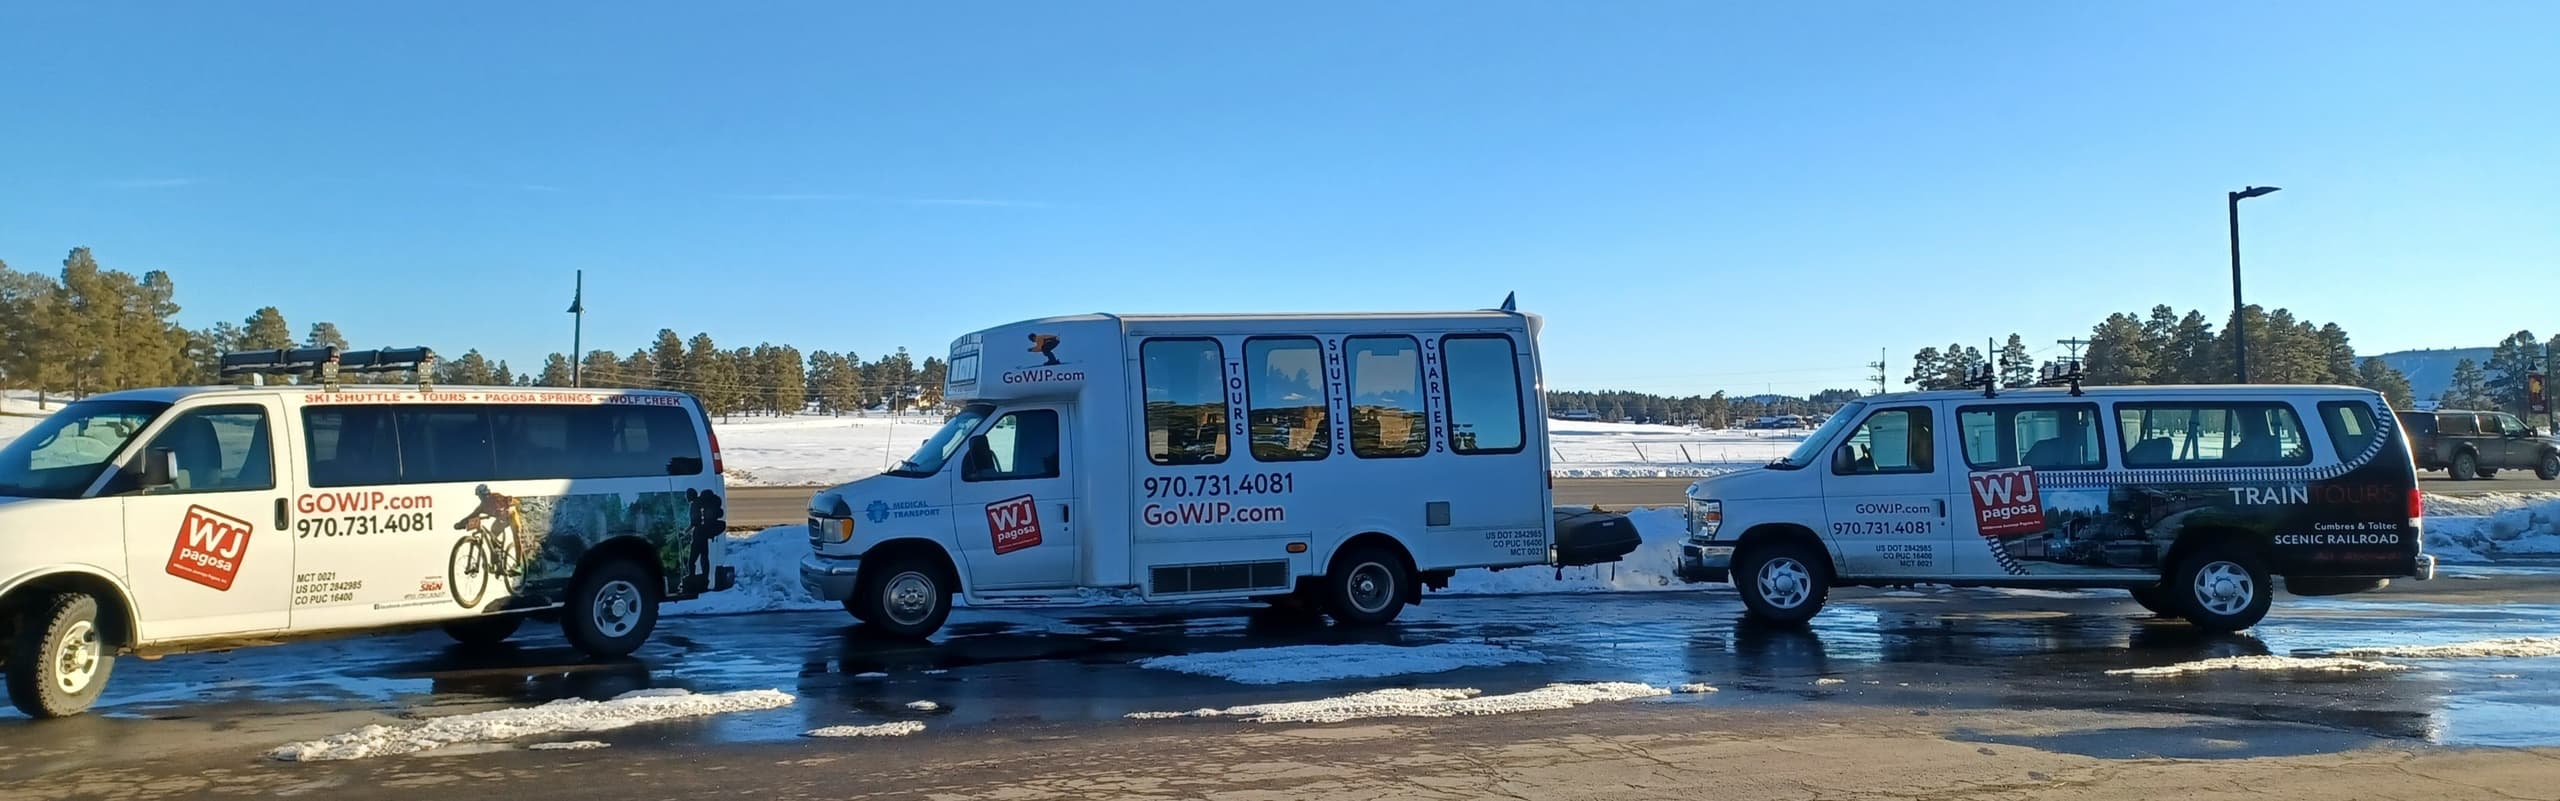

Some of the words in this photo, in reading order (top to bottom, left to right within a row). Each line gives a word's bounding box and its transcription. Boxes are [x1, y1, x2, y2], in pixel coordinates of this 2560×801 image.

[1002, 369, 1085, 384] GoWJP.com
[305, 394, 329, 403] SKI
[335, 393, 400, 402] SHUTTLE
[421, 393, 467, 402] TOURS
[485, 393, 537, 402] PAGOSA
[540, 393, 593, 403] SPRINGS
[608, 394, 641, 405] WOLF
[644, 396, 681, 406] CREEK
[1229, 362, 1244, 436] TOURS
[1329, 338, 1345, 455] SHUTTLES
[1425, 338, 1444, 453] CHARTERS
[1143, 472, 1293, 498] 970.731.4081
[1974, 474, 2033, 506] WJ
[297, 491, 433, 513] GOWJP.com
[893, 500, 929, 509] MEDICAL
[1855, 503, 1931, 514] GOWJP.com
[893, 508, 940, 519] TRANSPORT
[991, 502, 1034, 531] WJ
[1143, 502, 1284, 526] GoWJP.com
[1982, 504, 2037, 522] pagosa
[297, 512, 433, 539] 970.731.4081
[1833, 521, 1932, 535] 970.731.4081
[2314, 522, 2355, 531] Cumbres
[2357, 523, 2366, 531] &
[2367, 522, 2398, 531] Toltec
[189, 516, 244, 559] WJ
[997, 525, 1036, 543] pagosa
[1485, 532, 1496, 540] US
[1497, 531, 1513, 539] DOT
[2274, 535, 2324, 545] SCENIC
[2327, 534, 2399, 545] RAILROAD
[1492, 540, 1504, 548] CO
[1506, 540, 1521, 548] PUC
[179, 547, 233, 572] pagosa
[1882, 552, 1894, 560] CO
[1895, 552, 1911, 560] PUC
[296, 573, 316, 583] MCT
[295, 584, 308, 594] US
[309, 583, 329, 593] DOT
[294, 596, 309, 606] CO
[309, 594, 328, 604] PUC
